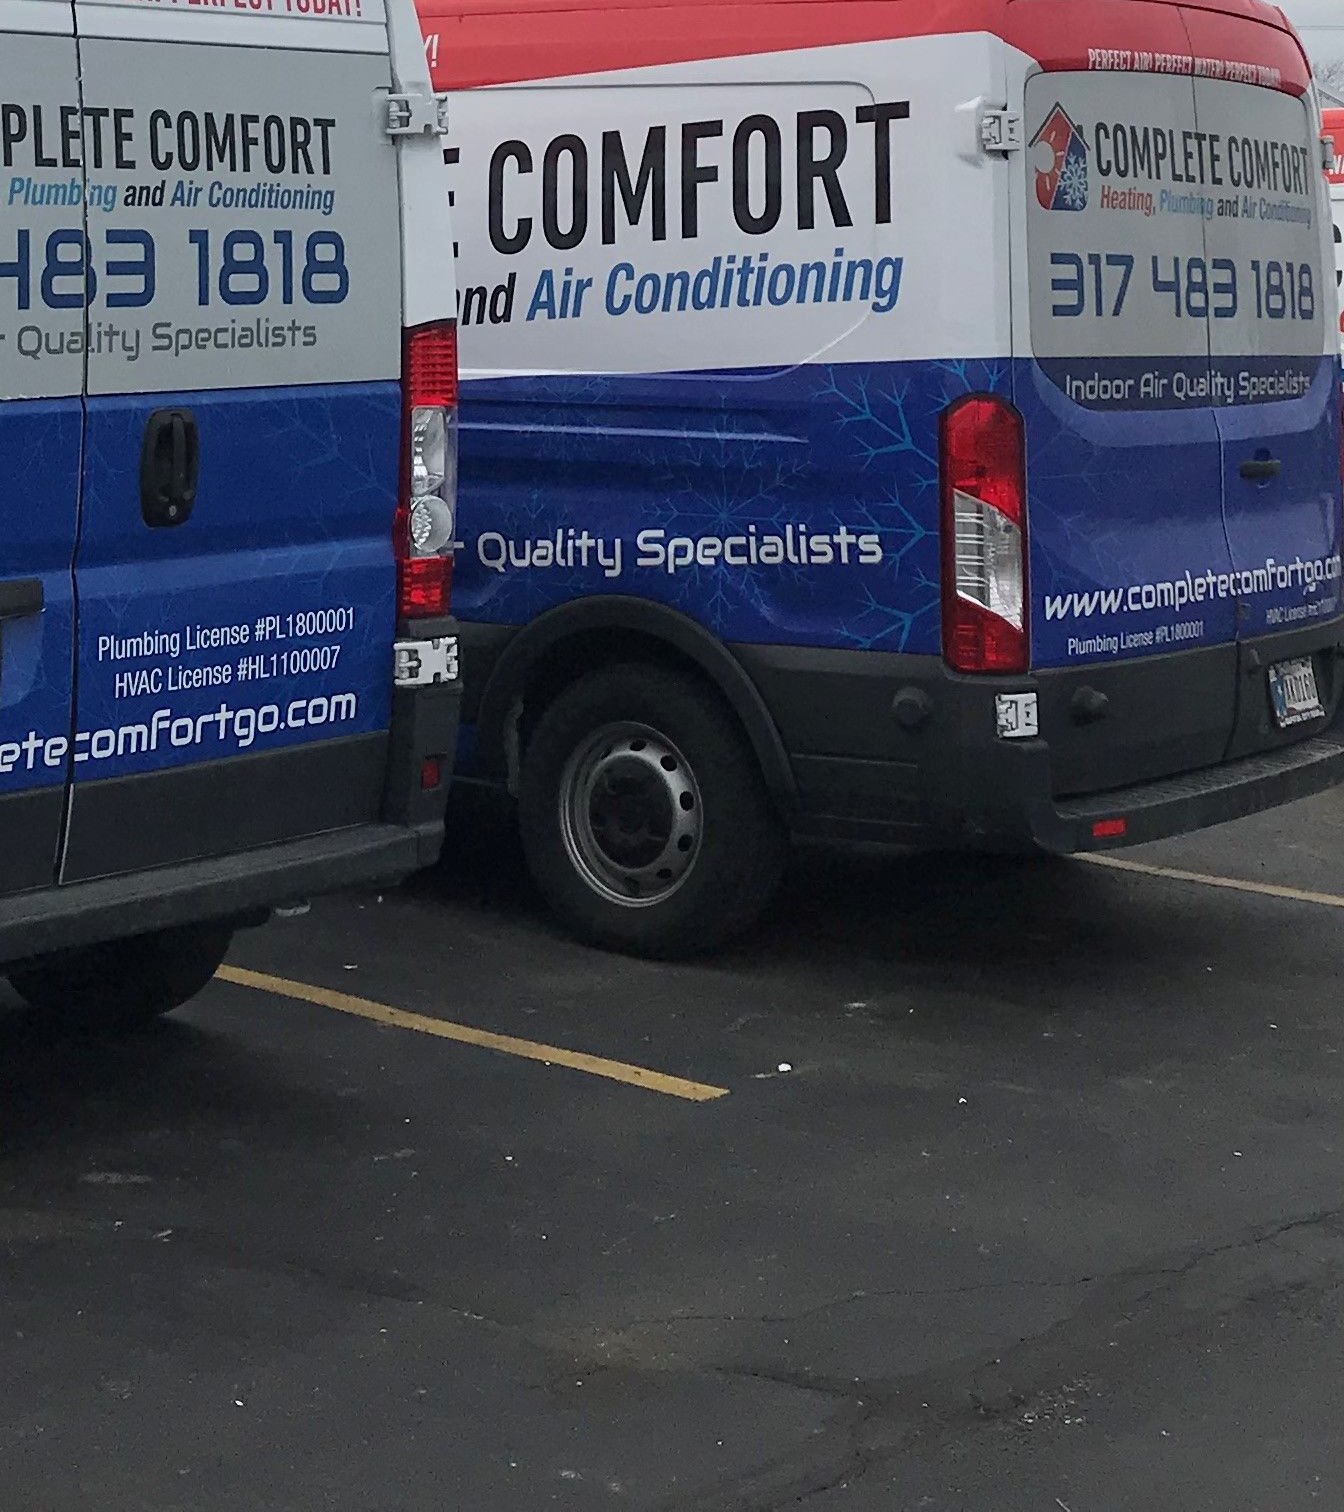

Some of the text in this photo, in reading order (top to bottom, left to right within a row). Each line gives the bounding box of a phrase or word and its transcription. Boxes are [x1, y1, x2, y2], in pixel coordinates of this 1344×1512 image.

[1088, 49, 1131, 69] PERFECT
[1155, 53, 1192, 74] PERFECT
[150, 108, 336, 176] COMFORT
[1094, 121, 1309, 195] COMPLETE COMFORT
[8, 177, 117, 212] Plumbing
[124, 180, 165, 207] and
[170, 182, 202, 208] Air
[208, 181, 334, 215] Conditioning
[488, 101, 910, 255] COMFORT
[1100, 185, 1155, 217] Heating,
[1217, 196, 1239, 218] and
[188, 228, 350, 308] 1818
[456, 247, 904, 326] nd Air Conditioning
[1050, 253, 1314, 320] 317 483 1818
[16, 323, 140, 362] Quality
[151, 318, 318, 352] Specialists
[1065, 371, 1310, 402] Indoor Air Quality Specialists
[477, 525, 883, 578] Quality Specialists
[97, 606, 355, 662] Plumbing License #PL1800001
[1068, 633, 1119, 655] Plumbing
[1120, 626, 1154, 649] License
[114, 646, 341, 699] HVAC License #HL1100007
